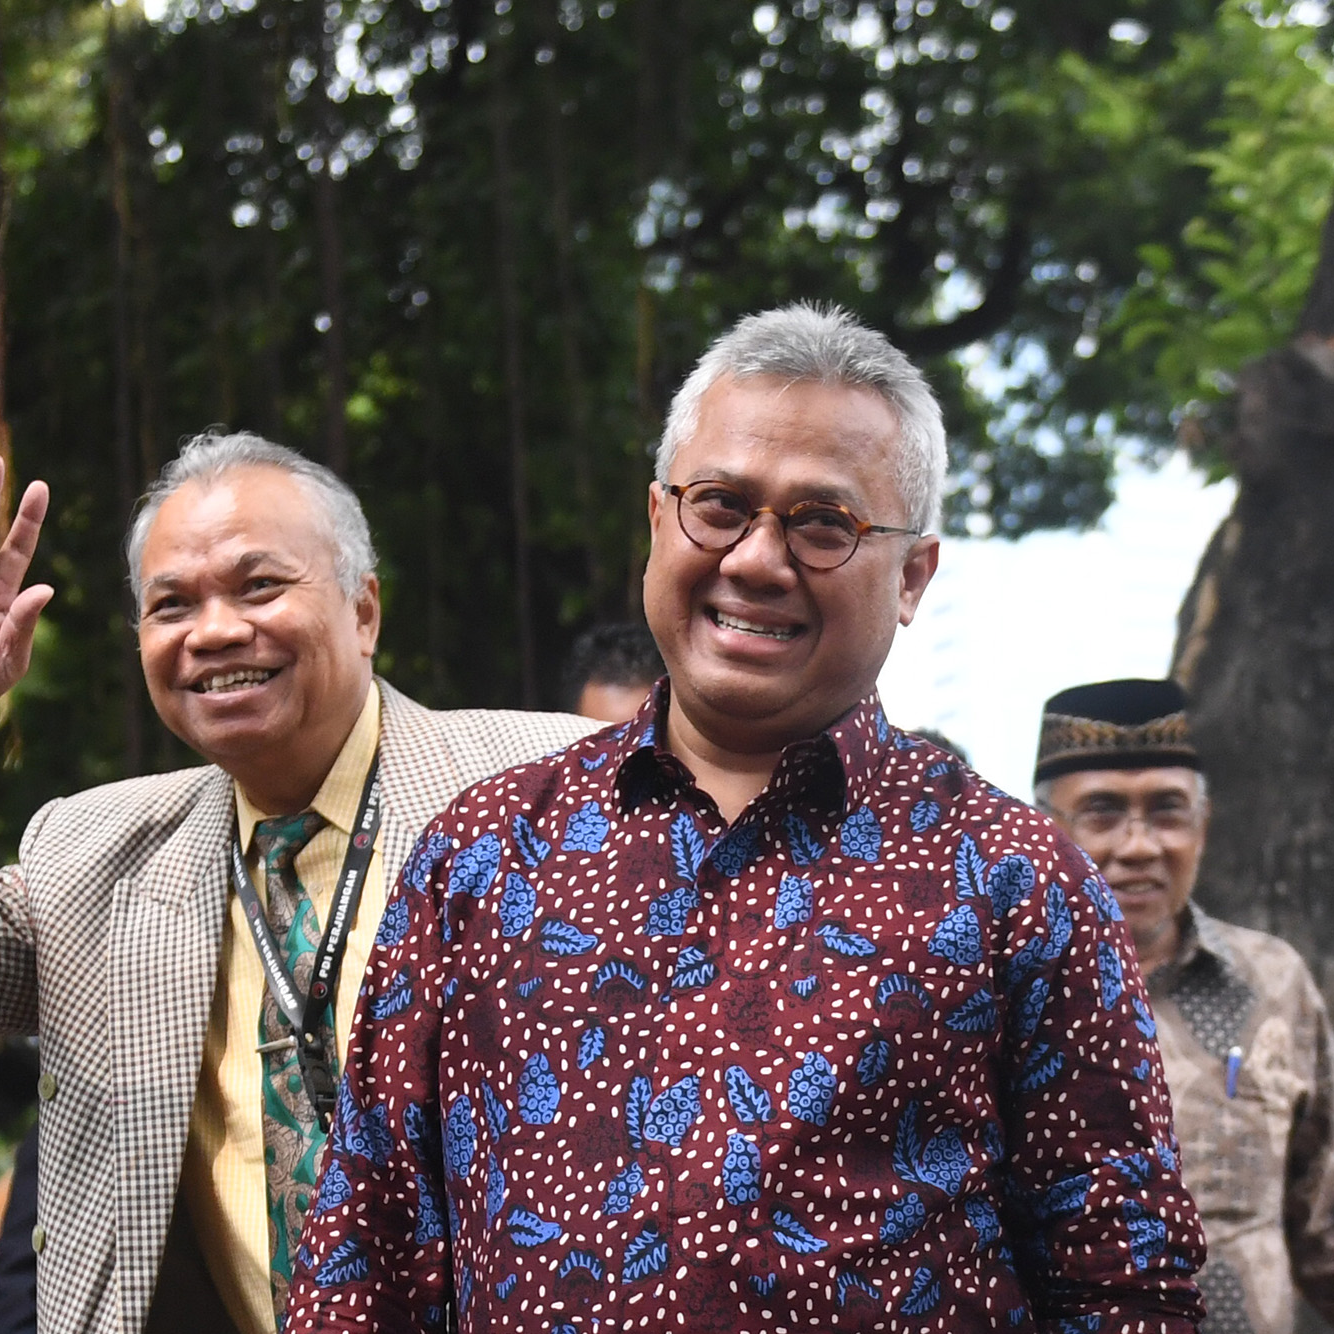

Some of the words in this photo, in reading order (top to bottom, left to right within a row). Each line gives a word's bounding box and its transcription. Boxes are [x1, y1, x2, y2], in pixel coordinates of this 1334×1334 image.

[362, 803, 376, 830] PDI
[253, 918, 264, 939] PDI
[260, 936, 298, 1010] PERJUANGAN
[319, 955, 333, 978] PDI
[326, 870, 358, 953] PERJUANGAN
